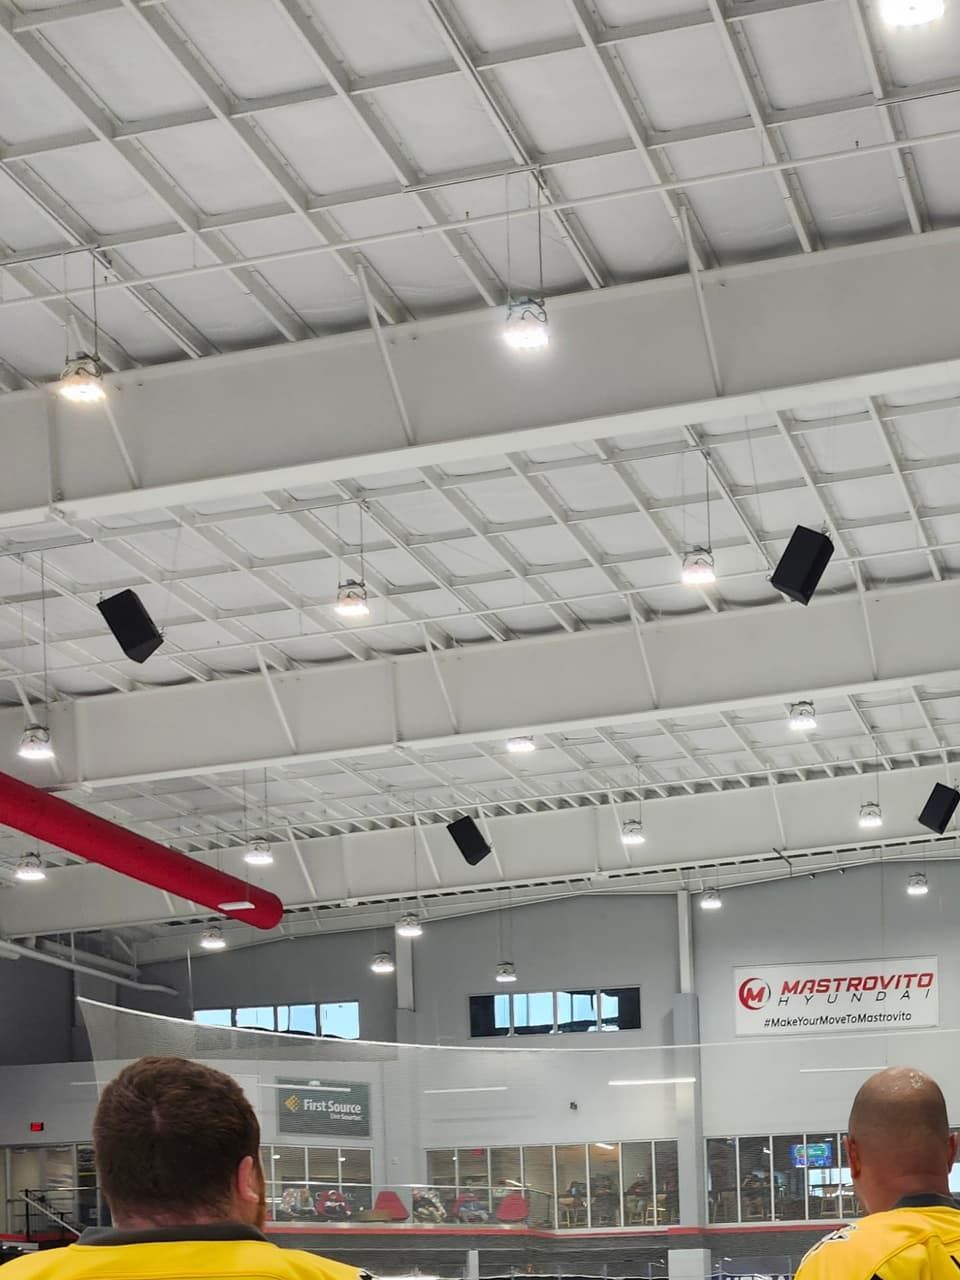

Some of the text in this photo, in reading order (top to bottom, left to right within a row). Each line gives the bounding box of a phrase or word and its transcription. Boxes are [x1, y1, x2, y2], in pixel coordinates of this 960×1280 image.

[781, 973, 934, 995] MASTROVITO
[778, 989, 930, 1006] HYUNDAI
[764, 1011, 912, 1028] #MakeYourMoveToMastrovito
[303, 1099, 361, 1114] First Source
